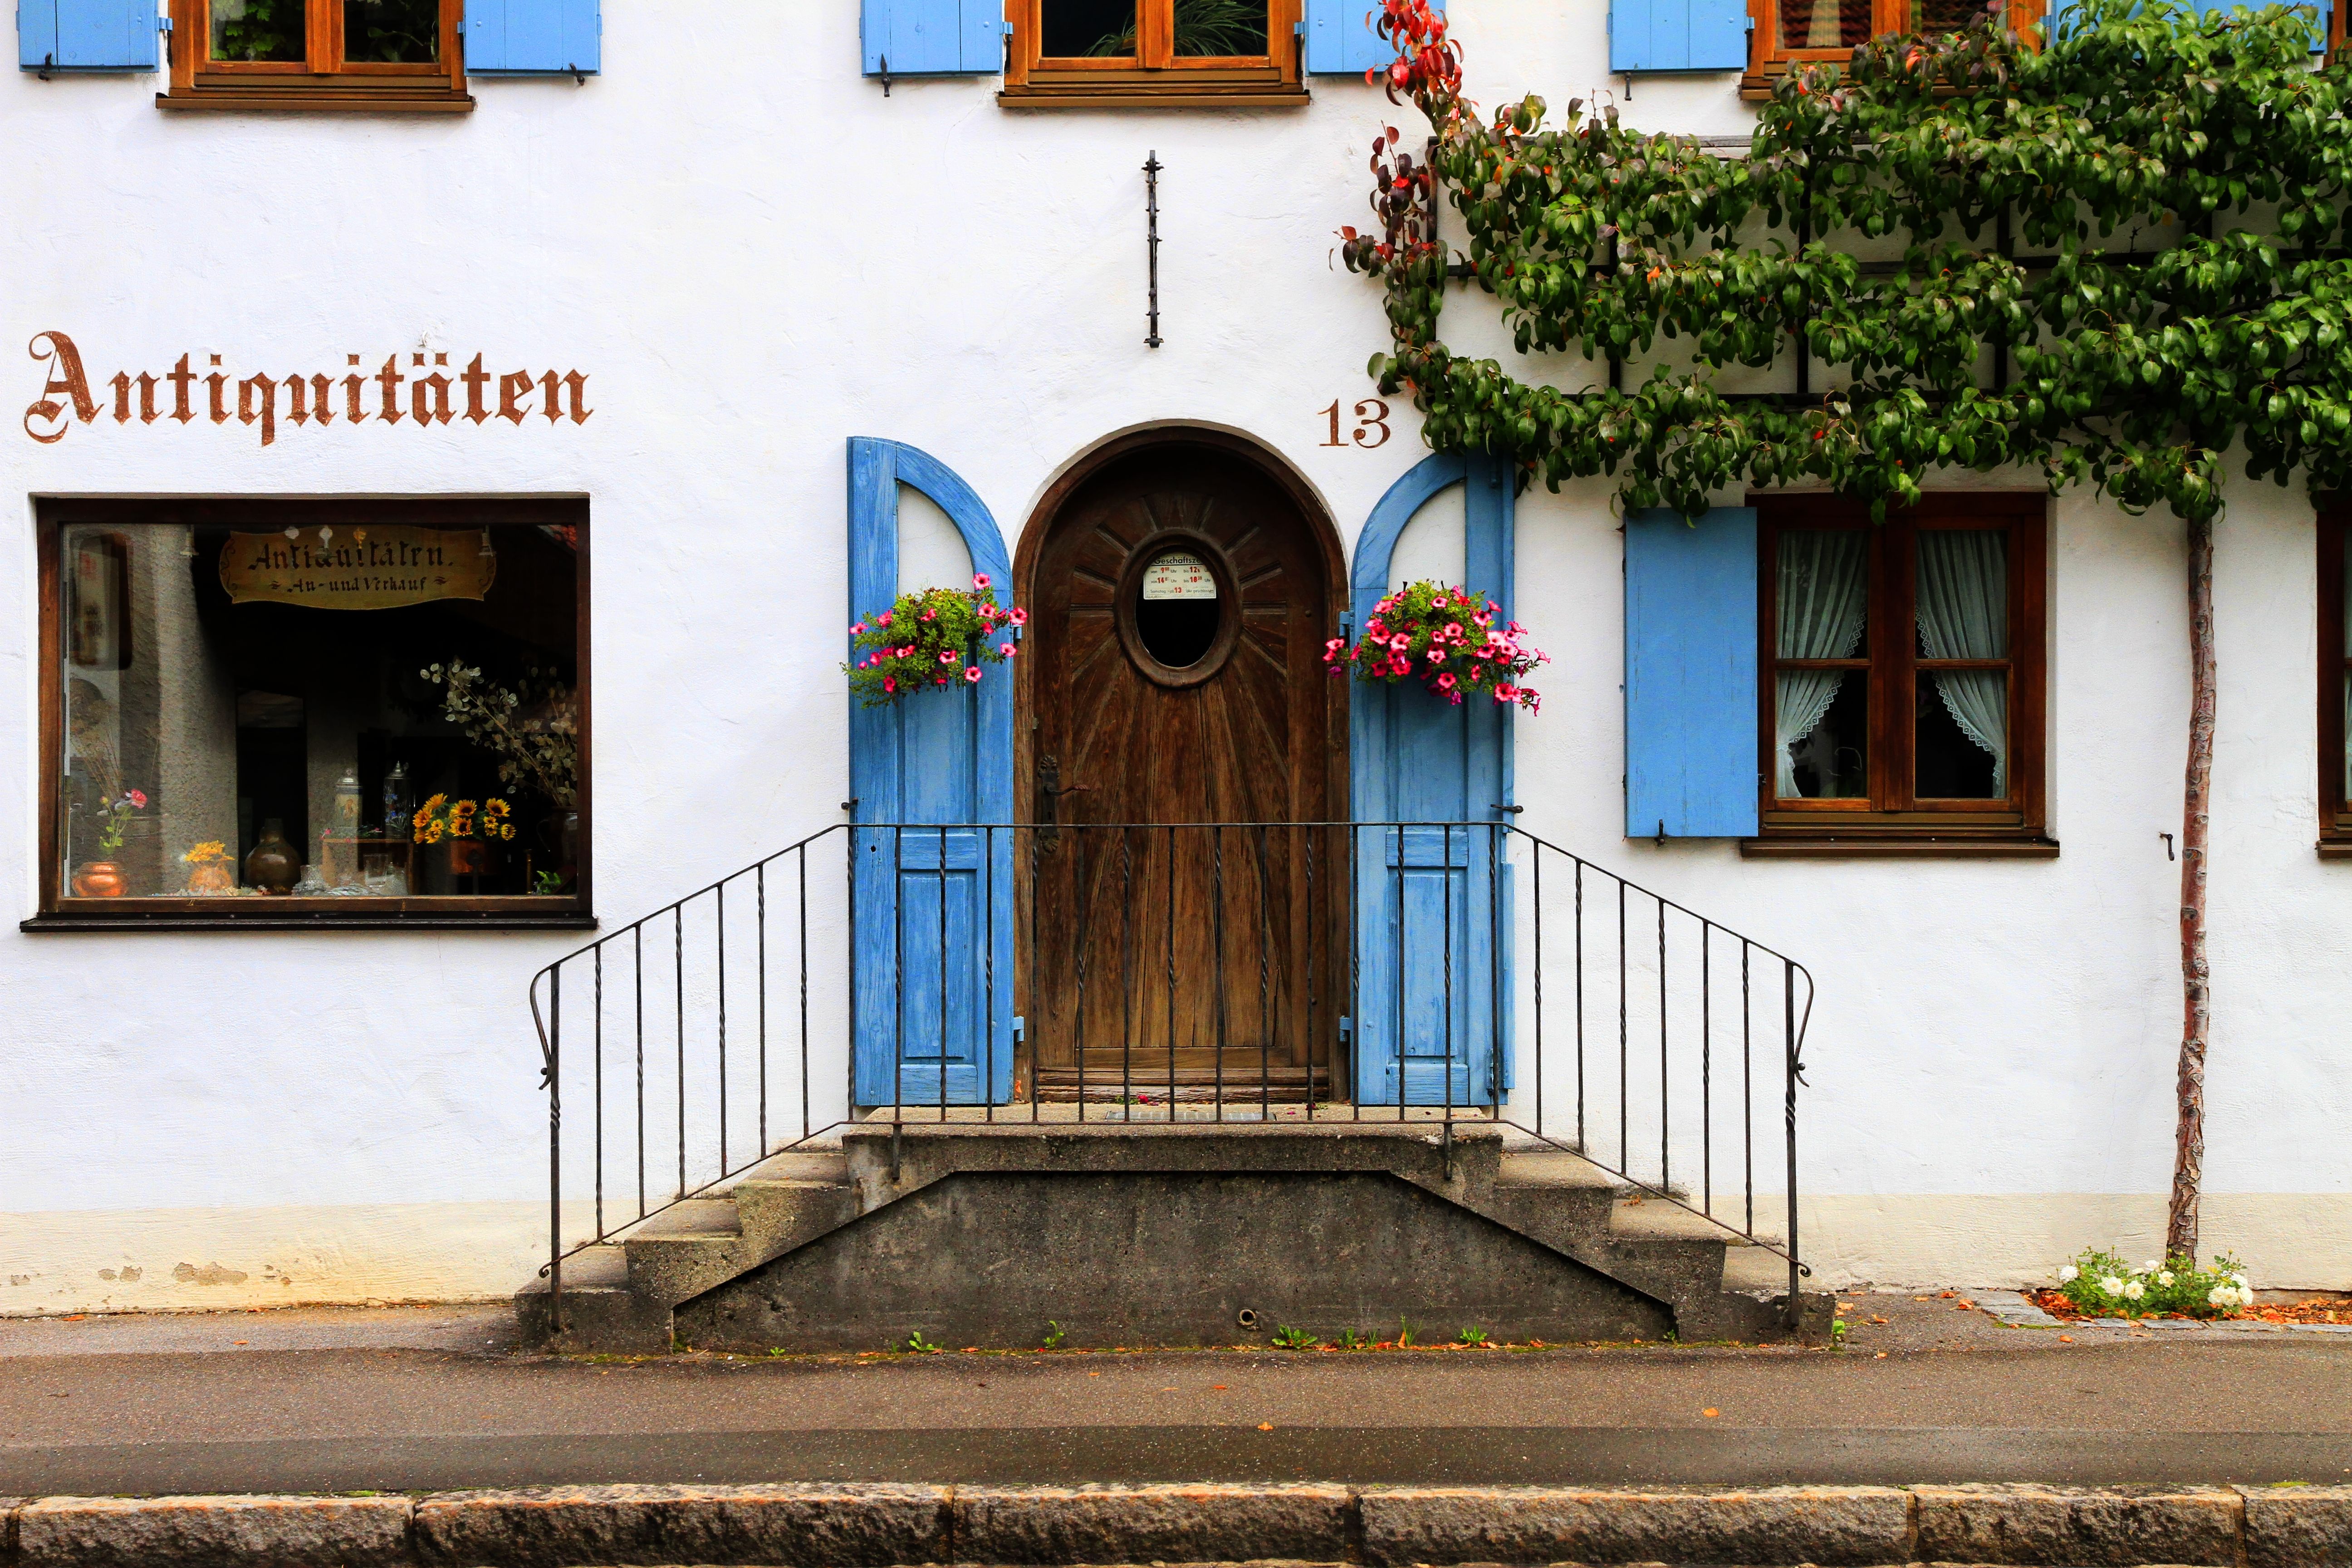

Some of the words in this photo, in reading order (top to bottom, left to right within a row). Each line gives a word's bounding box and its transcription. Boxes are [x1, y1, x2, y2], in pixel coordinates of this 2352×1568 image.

[24, 331, 593, 446] Antiquitäten
[1318, 398, 1390, 448] 13
[329, 577, 359, 592] und
[364, 577, 427, 594] Verkauf
